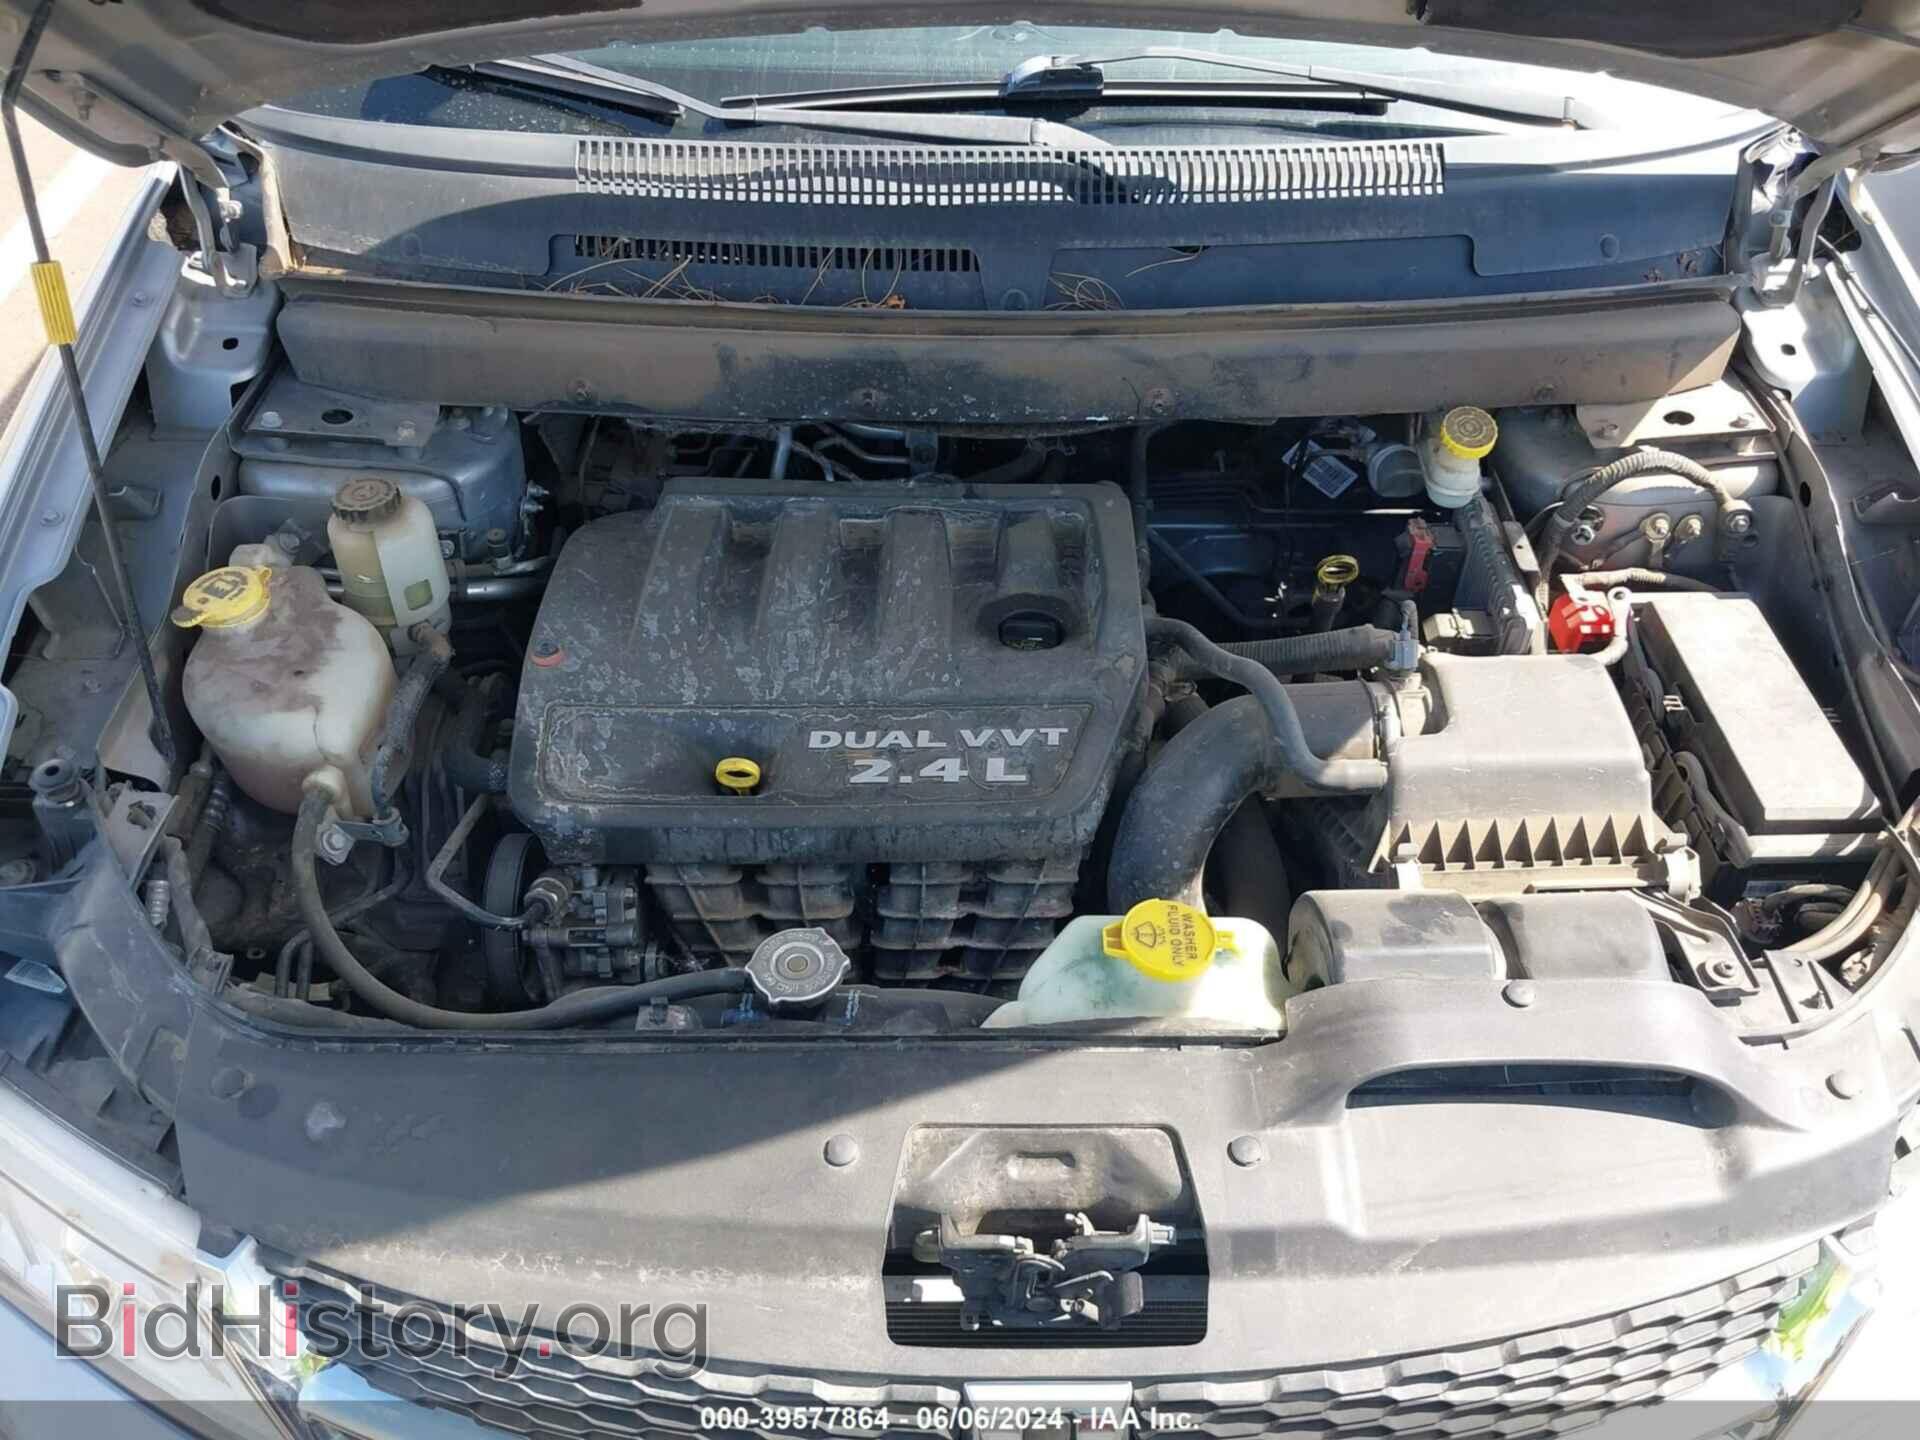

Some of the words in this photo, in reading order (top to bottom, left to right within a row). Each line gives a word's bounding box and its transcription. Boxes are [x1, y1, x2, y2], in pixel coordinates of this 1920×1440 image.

[808, 730, 947, 749] DUAL
[960, 727, 1069, 747] VVT
[1168, 904, 1181, 935] FLUID
[1182, 913, 1198, 960] WASHER
[1170, 938, 1185, 967] ONLY
